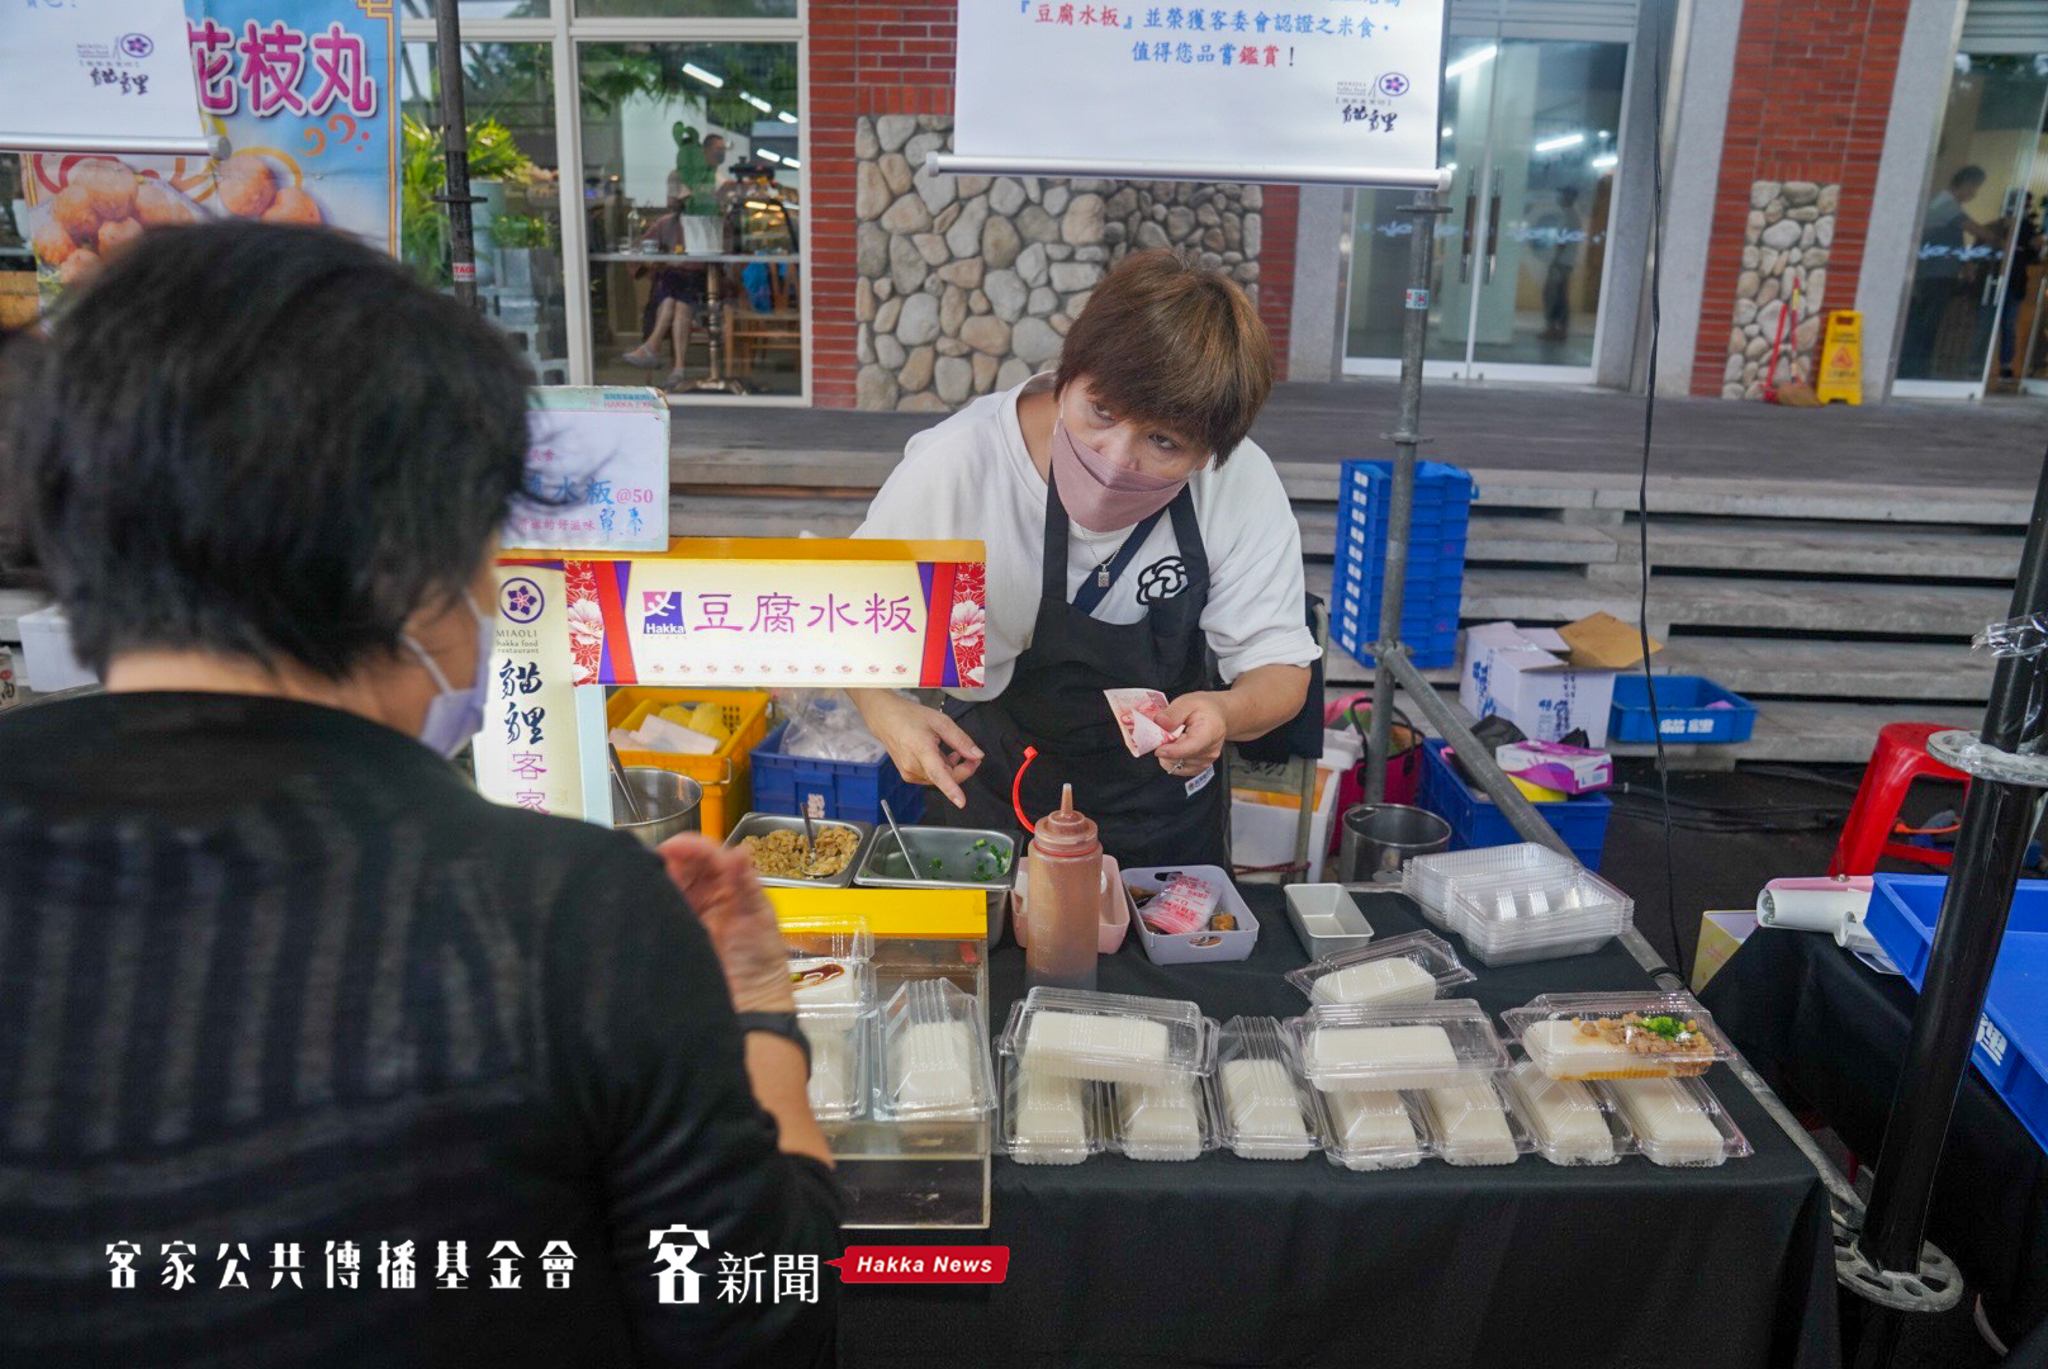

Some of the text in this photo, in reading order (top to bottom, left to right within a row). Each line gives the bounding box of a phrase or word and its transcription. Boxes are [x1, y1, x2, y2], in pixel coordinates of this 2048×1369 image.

[187, 20, 376, 116] 花枝丸
[616, 489, 654, 504] @50
[693, 592, 917, 633] 豆腐水粄
[496, 629, 538, 638] MIAOLI
[646, 623, 685, 634] Hakka
